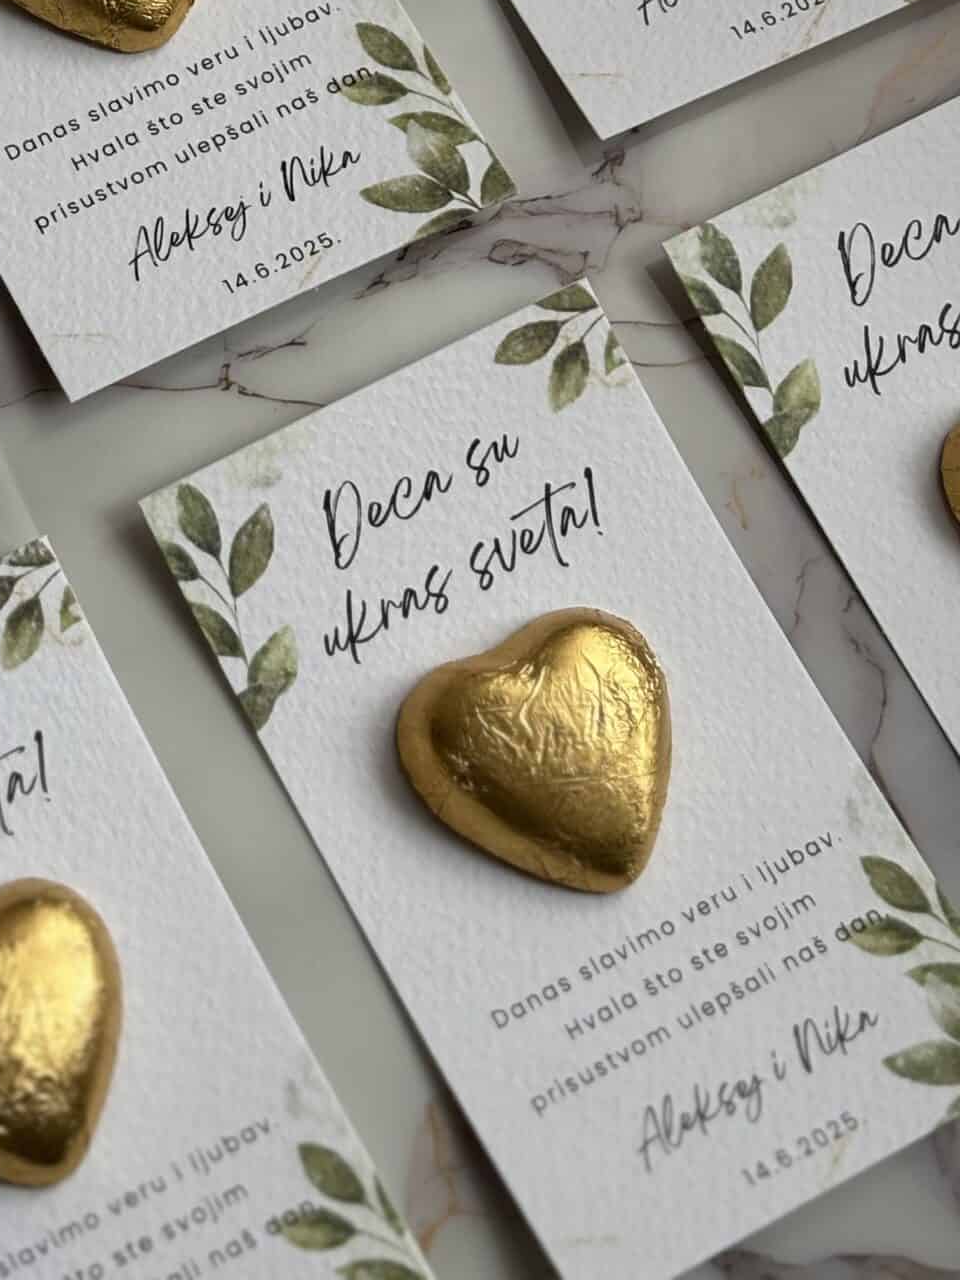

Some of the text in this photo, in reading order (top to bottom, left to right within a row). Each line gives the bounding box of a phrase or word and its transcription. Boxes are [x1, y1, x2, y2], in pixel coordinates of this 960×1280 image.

[3, 2, 341, 160] Danas slavimo veru i ljubav.
[70, 54, 312, 171] Hvala što ste svojim
[34, 161, 168, 235] prisustvom
[174, 110, 269, 164] ulepšali
[275, 88, 319, 118] naš
[128, 145, 360, 282] Aleksej i Nika
[221, 232, 342, 294] 14.6.2025.
[323, 434, 519, 570] Deca su
[323, 565, 453, 664] ukras
[489, 977, 571, 1029] Danas
[578, 920, 675, 981] slavimo
[680, 885, 737, 923] veru
[741, 872, 754, 893] i
[564, 895, 816, 1040] Hvala što ste svojim
[531, 1027, 671, 1118] prisustvom
[676, 964, 776, 1029] ulepšali
[782, 936, 828, 972] naš
[637, 1005, 878, 1172] Aleksej i Nika
